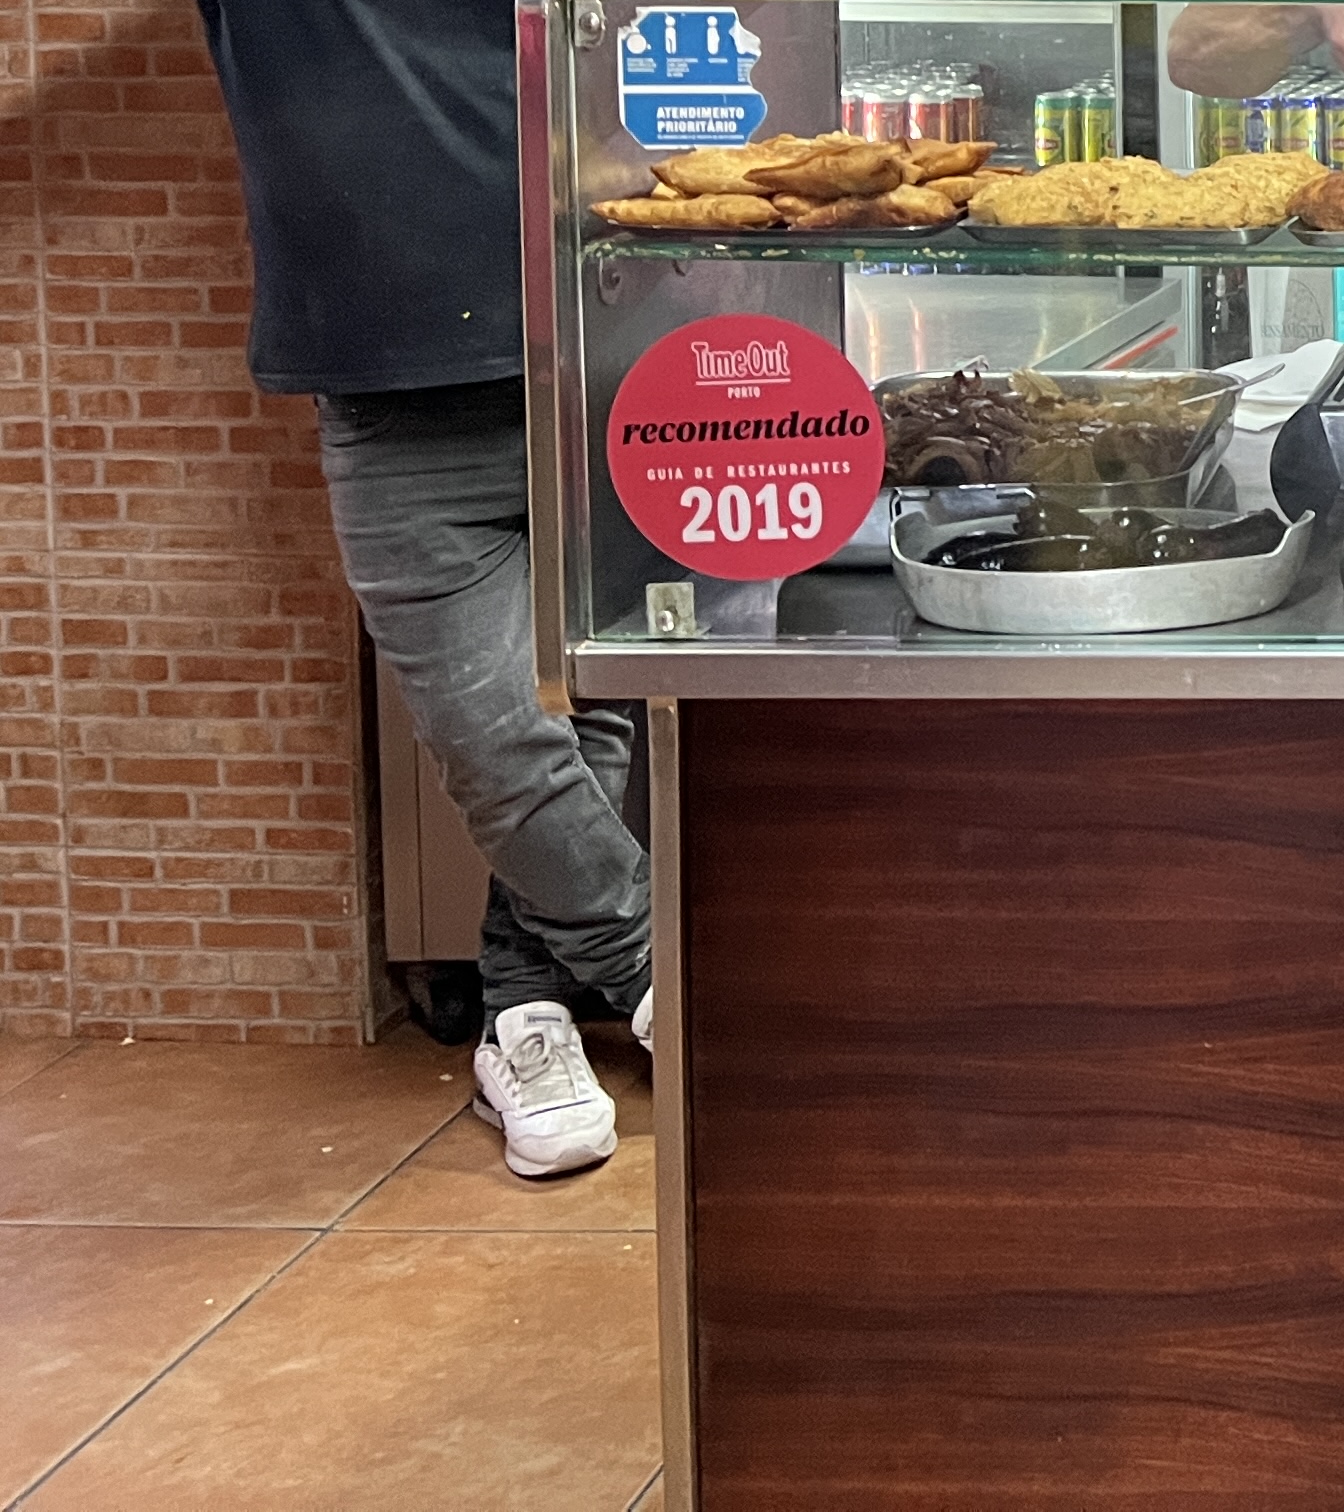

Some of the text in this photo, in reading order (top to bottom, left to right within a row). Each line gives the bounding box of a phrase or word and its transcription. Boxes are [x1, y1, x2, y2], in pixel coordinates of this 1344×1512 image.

[656, 106, 745, 120] ATENDIMENTO
[656, 117, 737, 133] PRIORITÁRIO
[727, 387, 761, 399] PORTO
[622, 408, 871, 446] recomendado
[646, 461, 851, 481] GUIA DE RESTAURANTES
[679, 481, 823, 544] 2019
